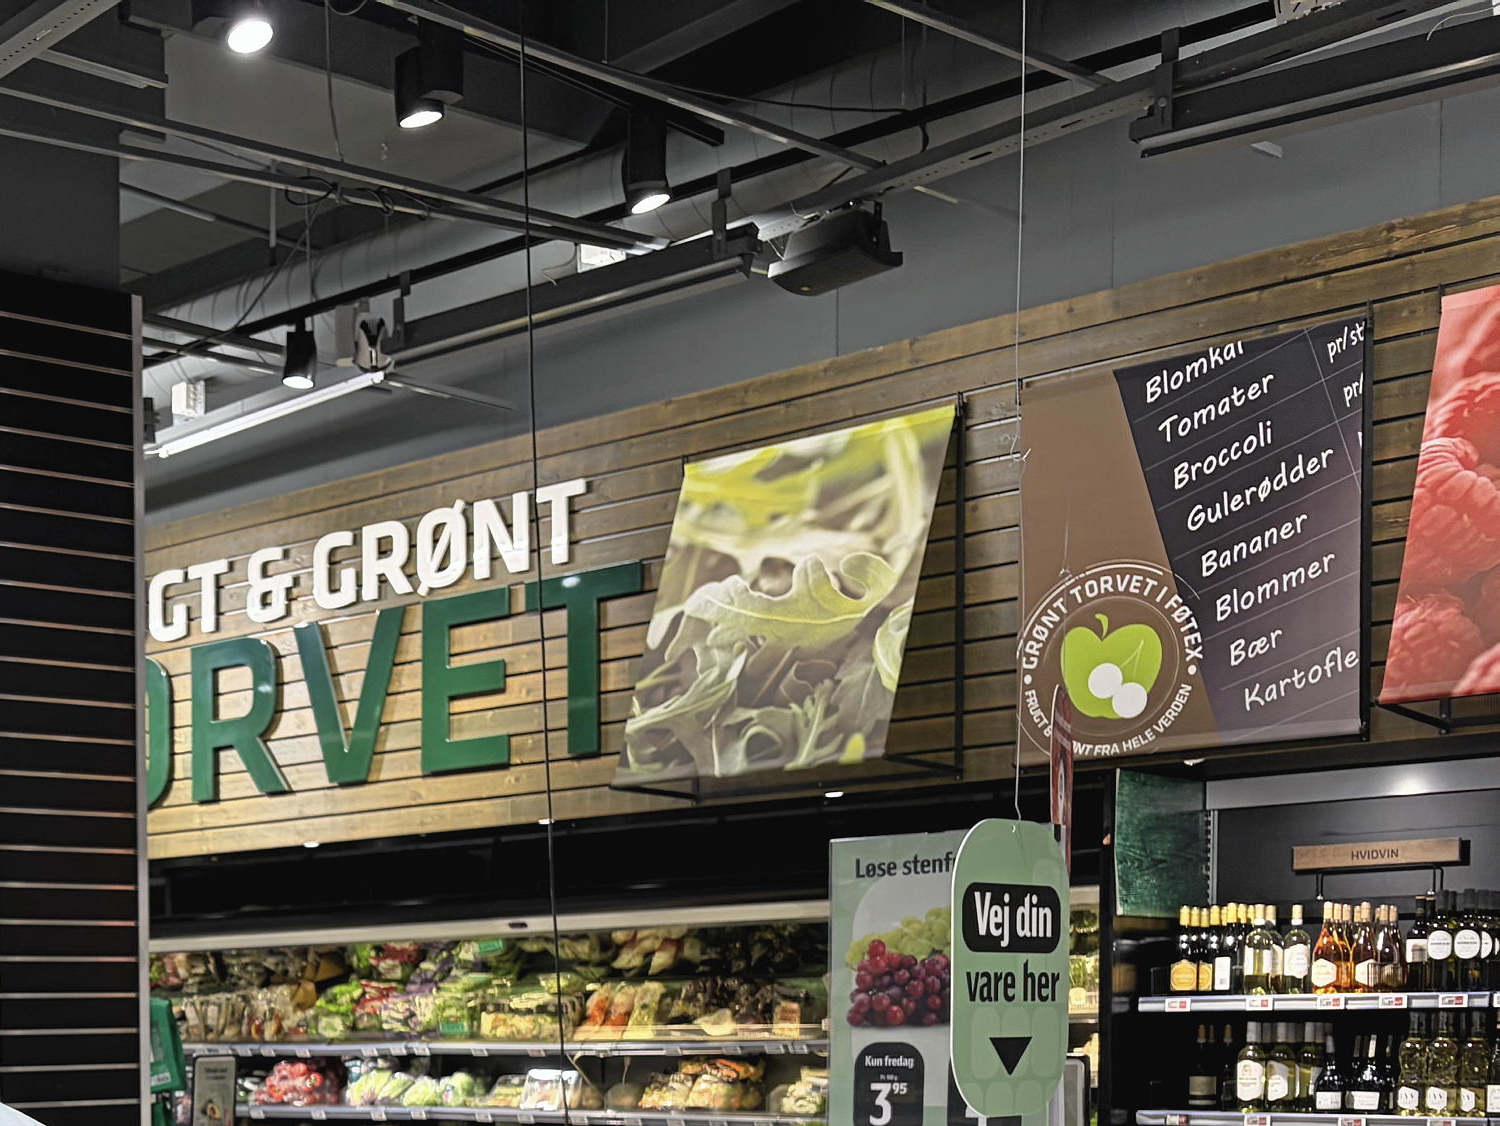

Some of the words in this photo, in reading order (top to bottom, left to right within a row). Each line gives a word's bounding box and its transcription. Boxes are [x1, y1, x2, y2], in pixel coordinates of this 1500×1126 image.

[1158, 374, 1274, 442] Tomater
[1173, 420, 1273, 490] Broccoli
[1187, 448, 1334, 531] Gulerødder
[246, 547, 300, 623] &
[312, 478, 587, 610] GRØNT
[1202, 514, 1308, 578] Bananer
[1216, 553, 1335, 622] Blommer
[1022, 597, 1068, 670] GRØNT
[1069, 574, 1158, 604] TORVET
[1155, 587, 1168, 603] I
[1164, 594, 1204, 662] FØTEX
[1230, 629, 1283, 666] Bær
[1244, 647, 1360, 711] Kartofle
[1025, 689, 1049, 728] FRUGT
[1094, 743, 1120, 757] FRA
[1122, 728, 1157, 752] HELE
[1153, 683, 1192, 733] VERDEN
[855, 858, 897, 878] Løse
[902, 851, 956, 876] stenf
[1351, 848, 1399, 860] HVIDVIN
[974, 891, 1010, 948] Vej
[1016, 893, 1052, 938] din
[966, 970, 1016, 1002] vare
[1023, 959, 1060, 1002] her
[865, 1056, 883, 1067] Kun
[884, 1055, 914, 1069] fredag
[869, 1083, 892, 1126] 3
[892, 1083, 908, 1094] 95
